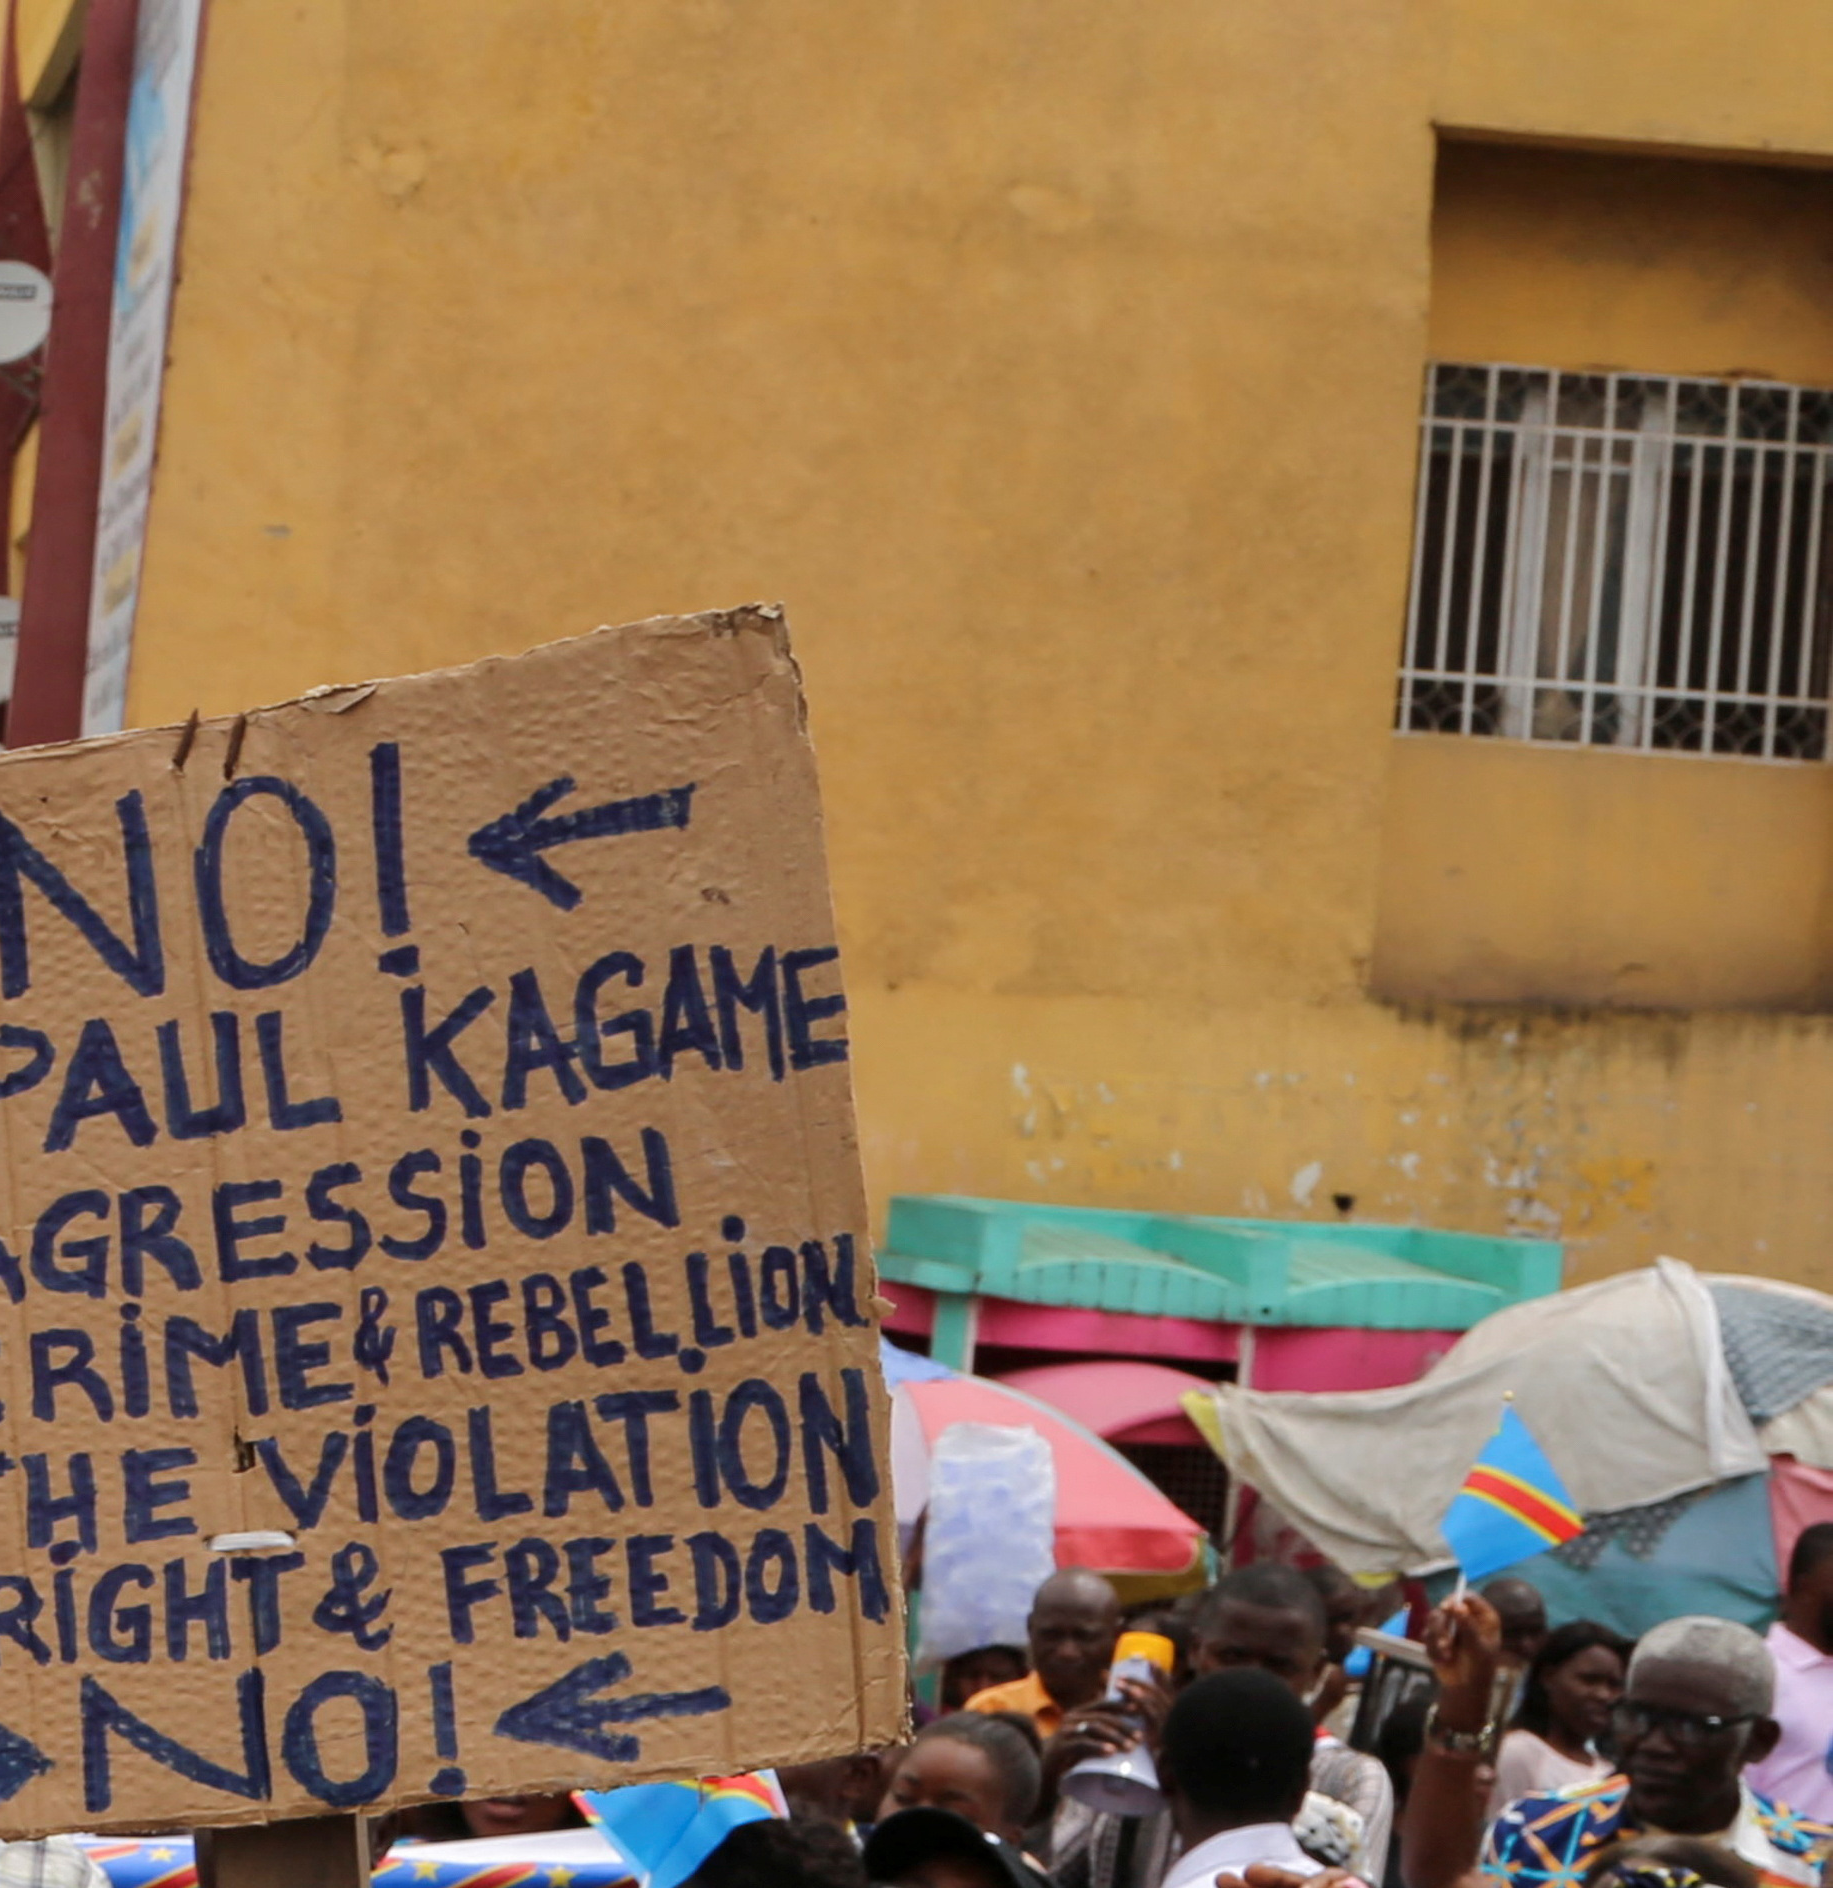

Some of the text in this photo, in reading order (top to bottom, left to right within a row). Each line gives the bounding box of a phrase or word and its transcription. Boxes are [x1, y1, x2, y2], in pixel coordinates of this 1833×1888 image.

[403, 943, 849, 1119] KAGAME
[440, 1518, 891, 1647] FREEDOM
[80, 1661, 468, 1816] NO!
